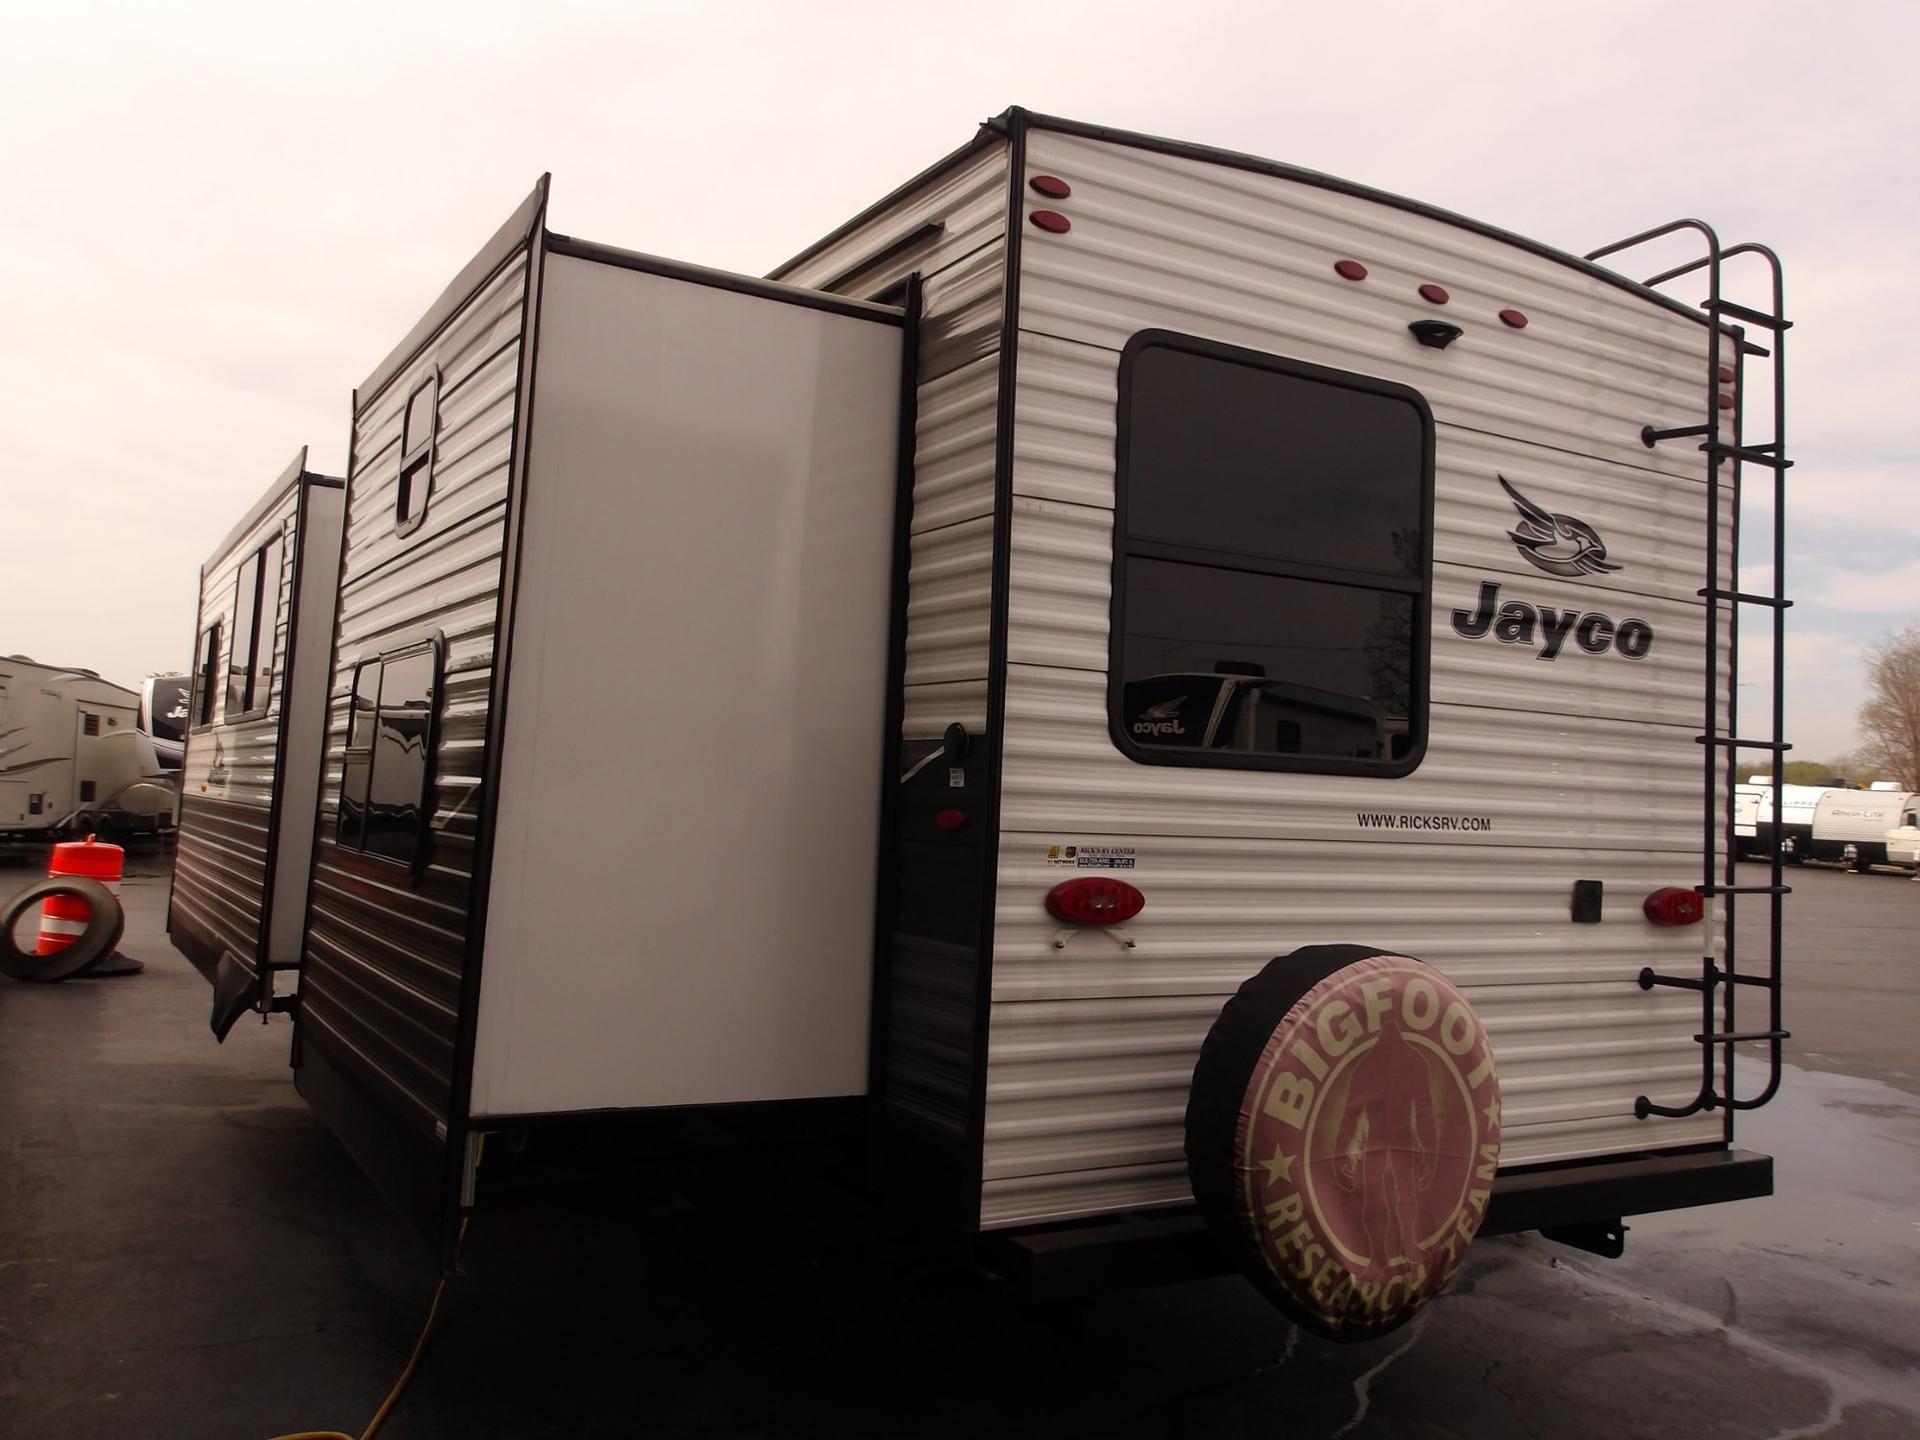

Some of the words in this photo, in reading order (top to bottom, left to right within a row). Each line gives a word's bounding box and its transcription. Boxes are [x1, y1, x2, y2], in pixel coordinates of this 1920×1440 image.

[1451, 581, 1654, 661] Jayco
[1357, 813, 1491, 831] WWW.RICKSRV.COM
[1263, 977, 1499, 1130] BIGFOOT
[1263, 1191, 1428, 1313] RESEARCH
[1439, 1143, 1499, 1261] TEAM
